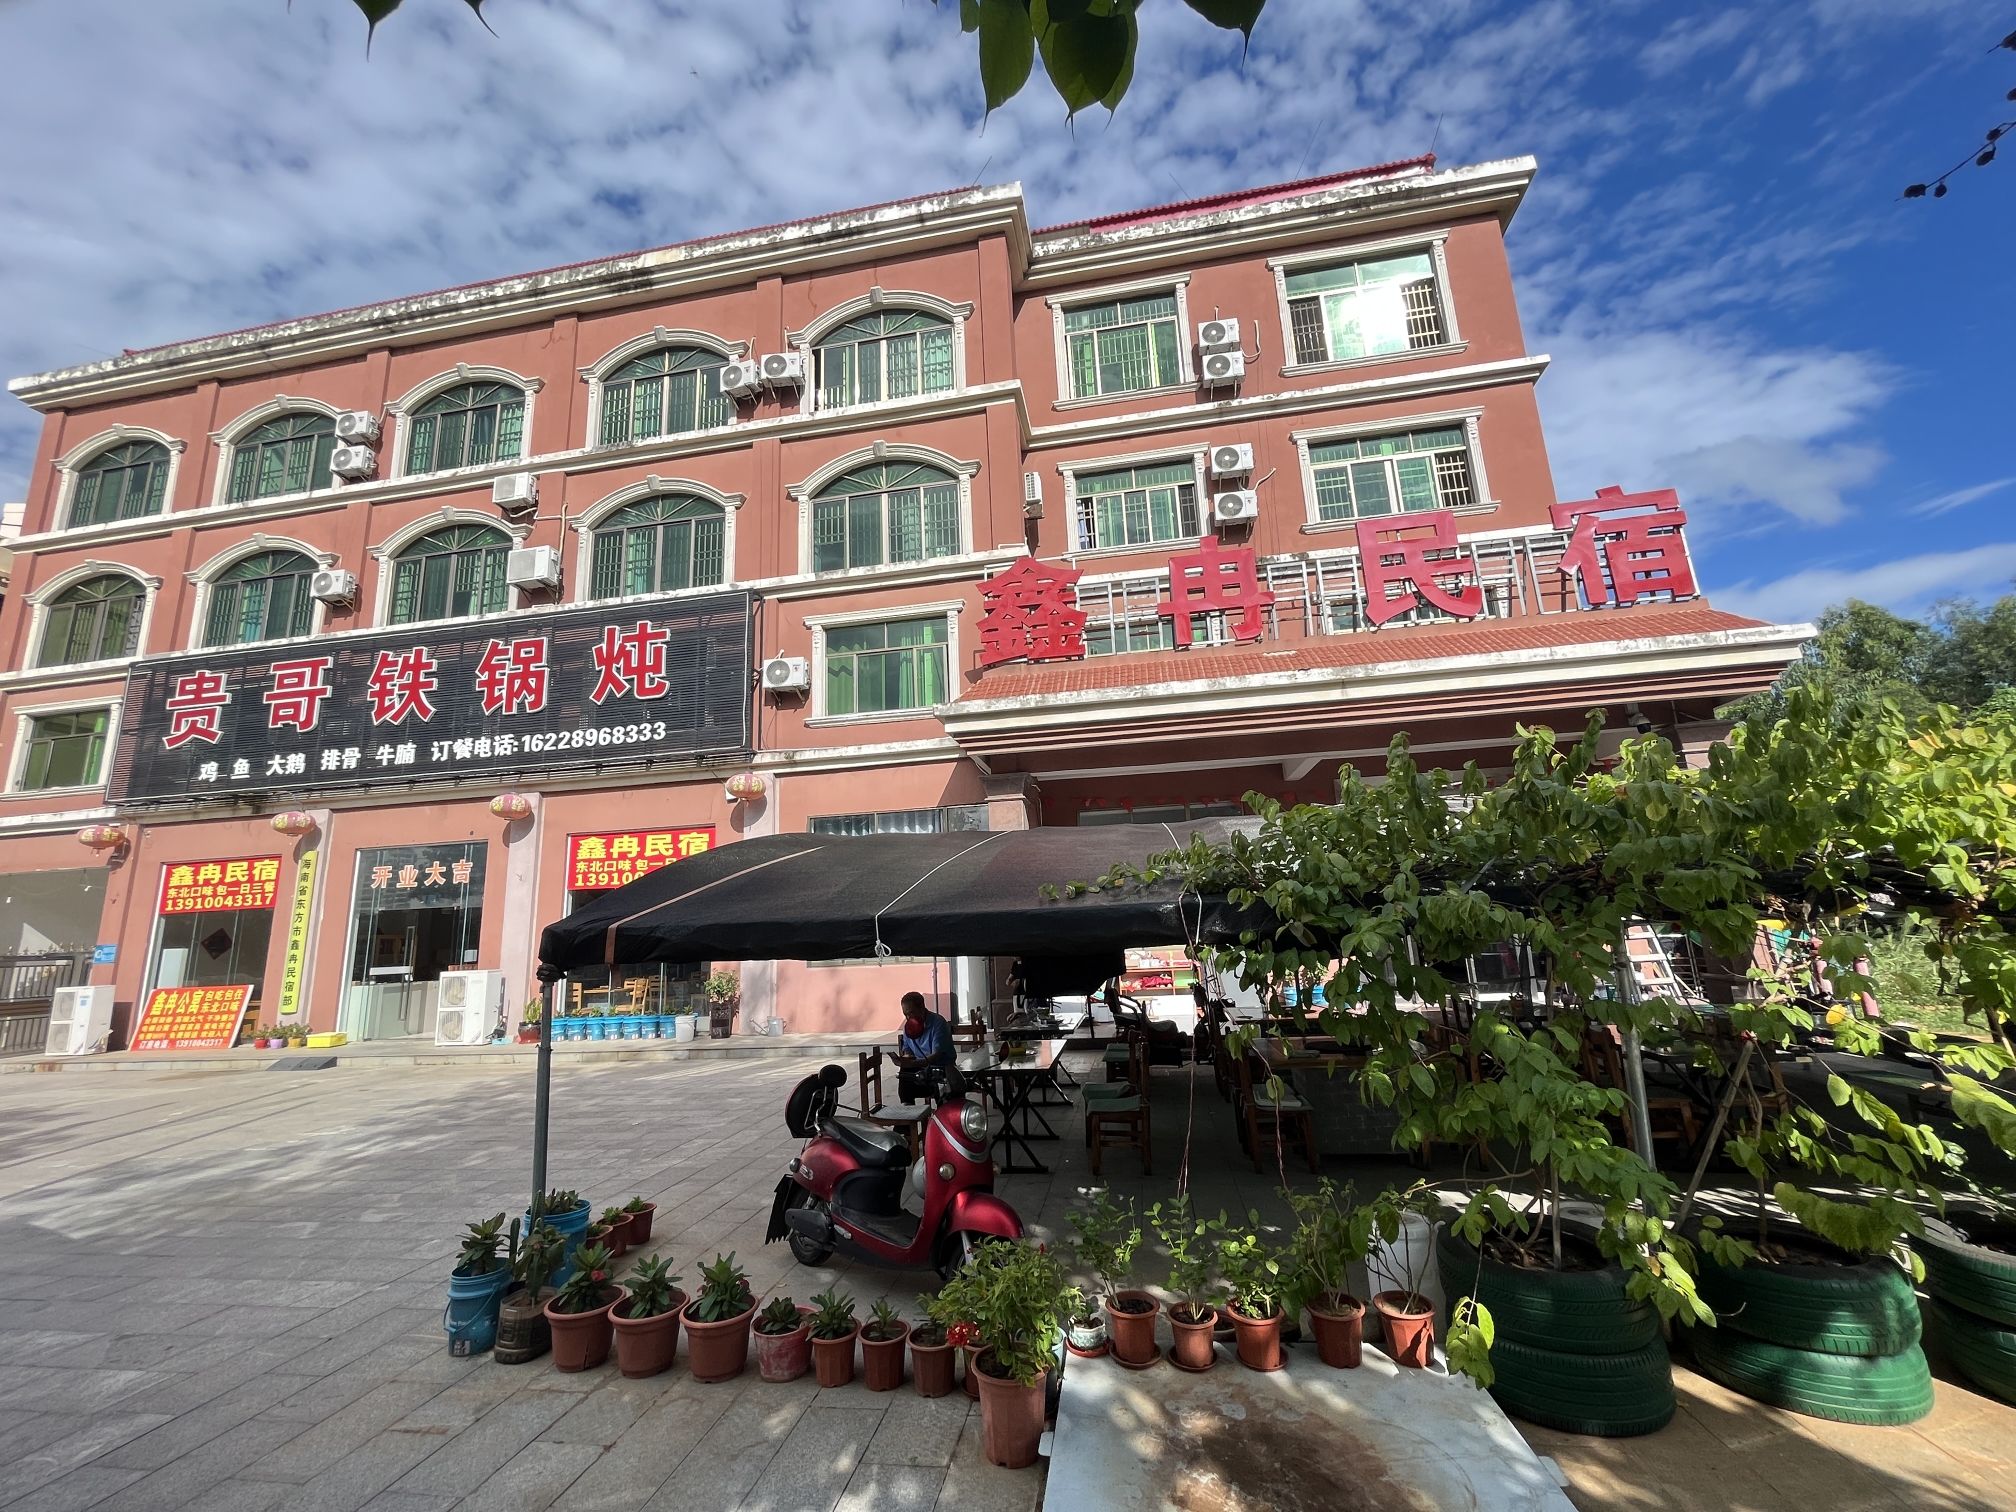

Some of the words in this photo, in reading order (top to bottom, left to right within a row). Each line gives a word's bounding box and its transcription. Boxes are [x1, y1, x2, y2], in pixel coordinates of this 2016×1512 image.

[976, 485, 1696, 665] 鑫冉民宿
[162, 620, 671, 750] 贵哥铁锅炖
[198, 761, 220, 783] 鸡
[230, 758, 251, 780] 鱼
[266, 752, 306, 776] 大鹅
[321, 747, 362, 771] 排骨
[375, 742, 417, 766] 牛腩
[576, 832, 710, 860] 鑫冉民宿
[168, 859, 279, 887] 鑫冉民宿
[370, 859, 473, 889] 开业大吉
[576, 859, 632, 873] 东北口味
[165, 893, 274, 911] 13910043317
[167, 885, 214, 899] 东北口味
[216, 881, 275, 896] 包一日三餐
[282, 859, 312, 1007] 海南省东方市鑫冉民宿部
